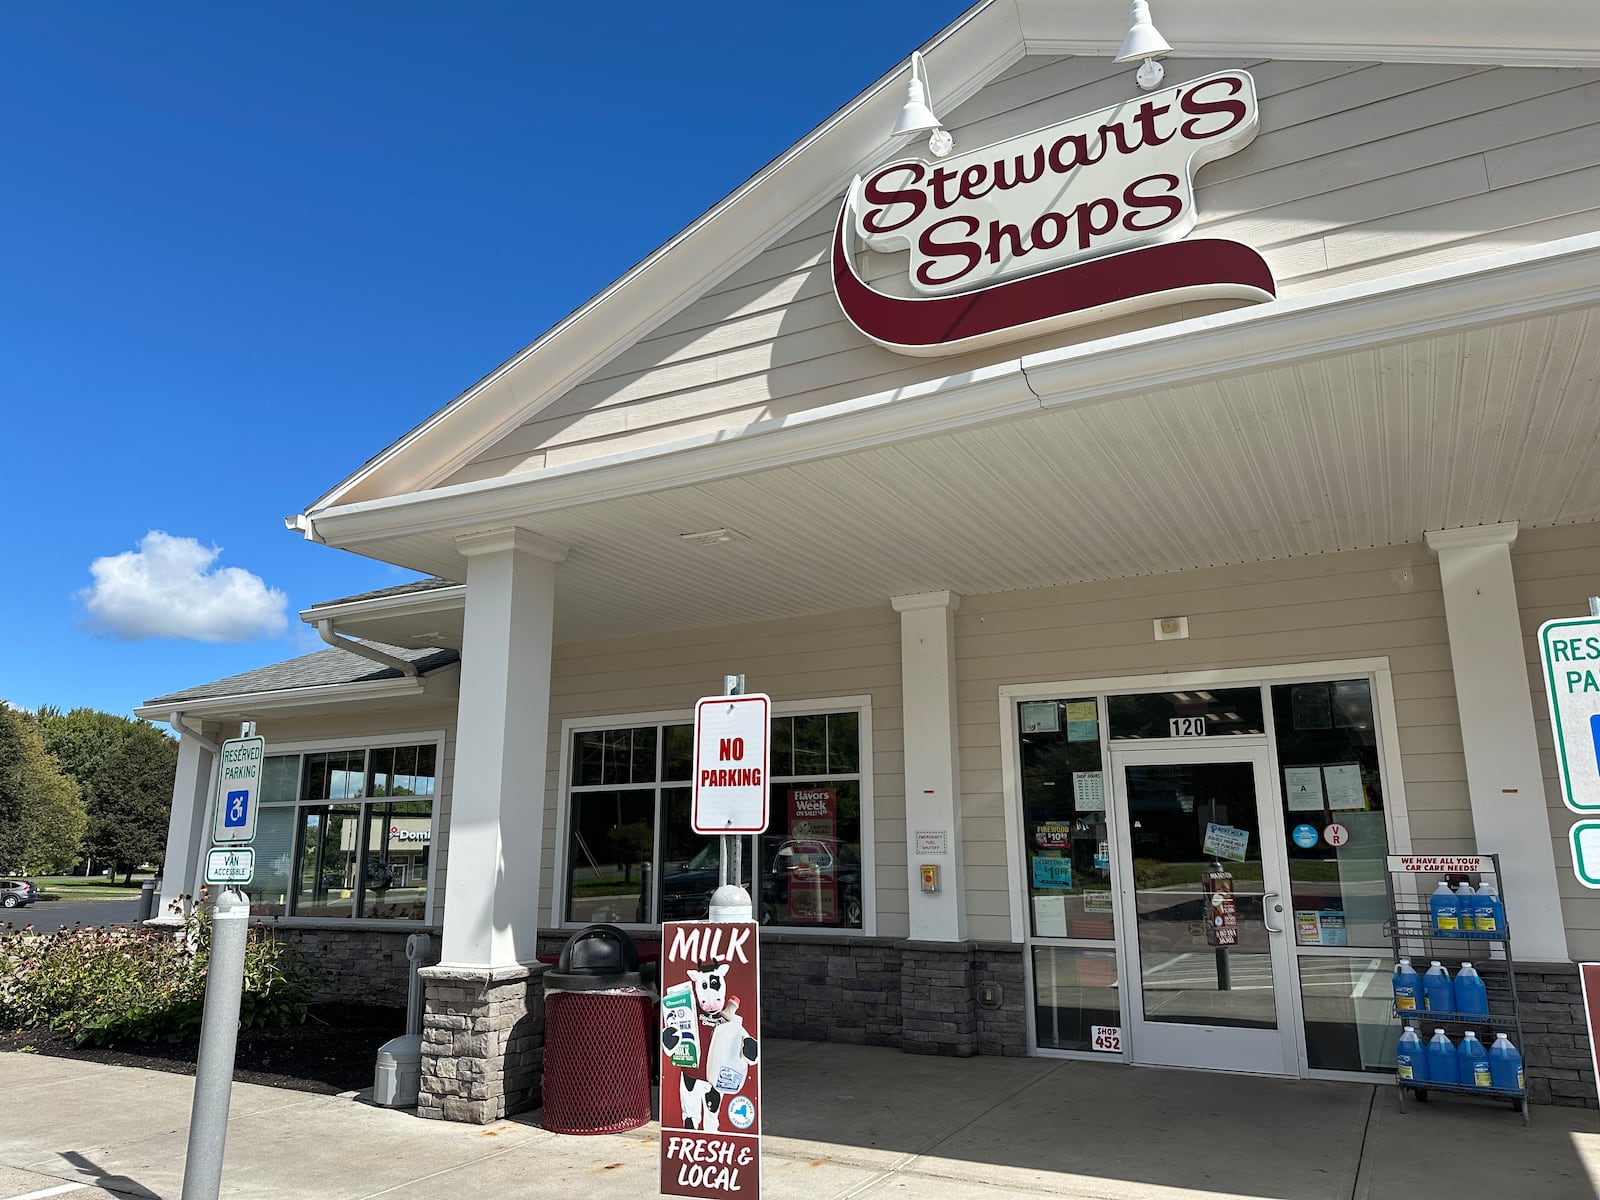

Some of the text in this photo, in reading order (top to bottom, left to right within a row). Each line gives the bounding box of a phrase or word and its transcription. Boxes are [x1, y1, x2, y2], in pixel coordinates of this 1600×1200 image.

[1566, 670, 1600, 694] PA
[1172, 718, 1204, 736] 120
[224, 747, 260, 763] RESERVED
[719, 737, 744, 761] NO
[224, 765, 256, 780] PARKING
[701, 768, 761, 787] PARKING
[794, 790, 830, 801] Flavors
[796, 800, 826, 811] Week
[1036, 825, 1070, 833] FIREWOOD
[1332, 826, 1339, 834] V
[1333, 835, 1341, 844] R
[224, 855, 240, 867] VAN
[213, 868, 246, 876] ACCESSIBLE
[1054, 866, 1069, 877] OFF
[668, 927, 751, 964] MILK
[1097, 1027, 1118, 1036] SHOP
[1095, 1036, 1120, 1050] 452
[666, 1136, 754, 1166] FRESH &
[677, 1163, 741, 1191] LOCAL
